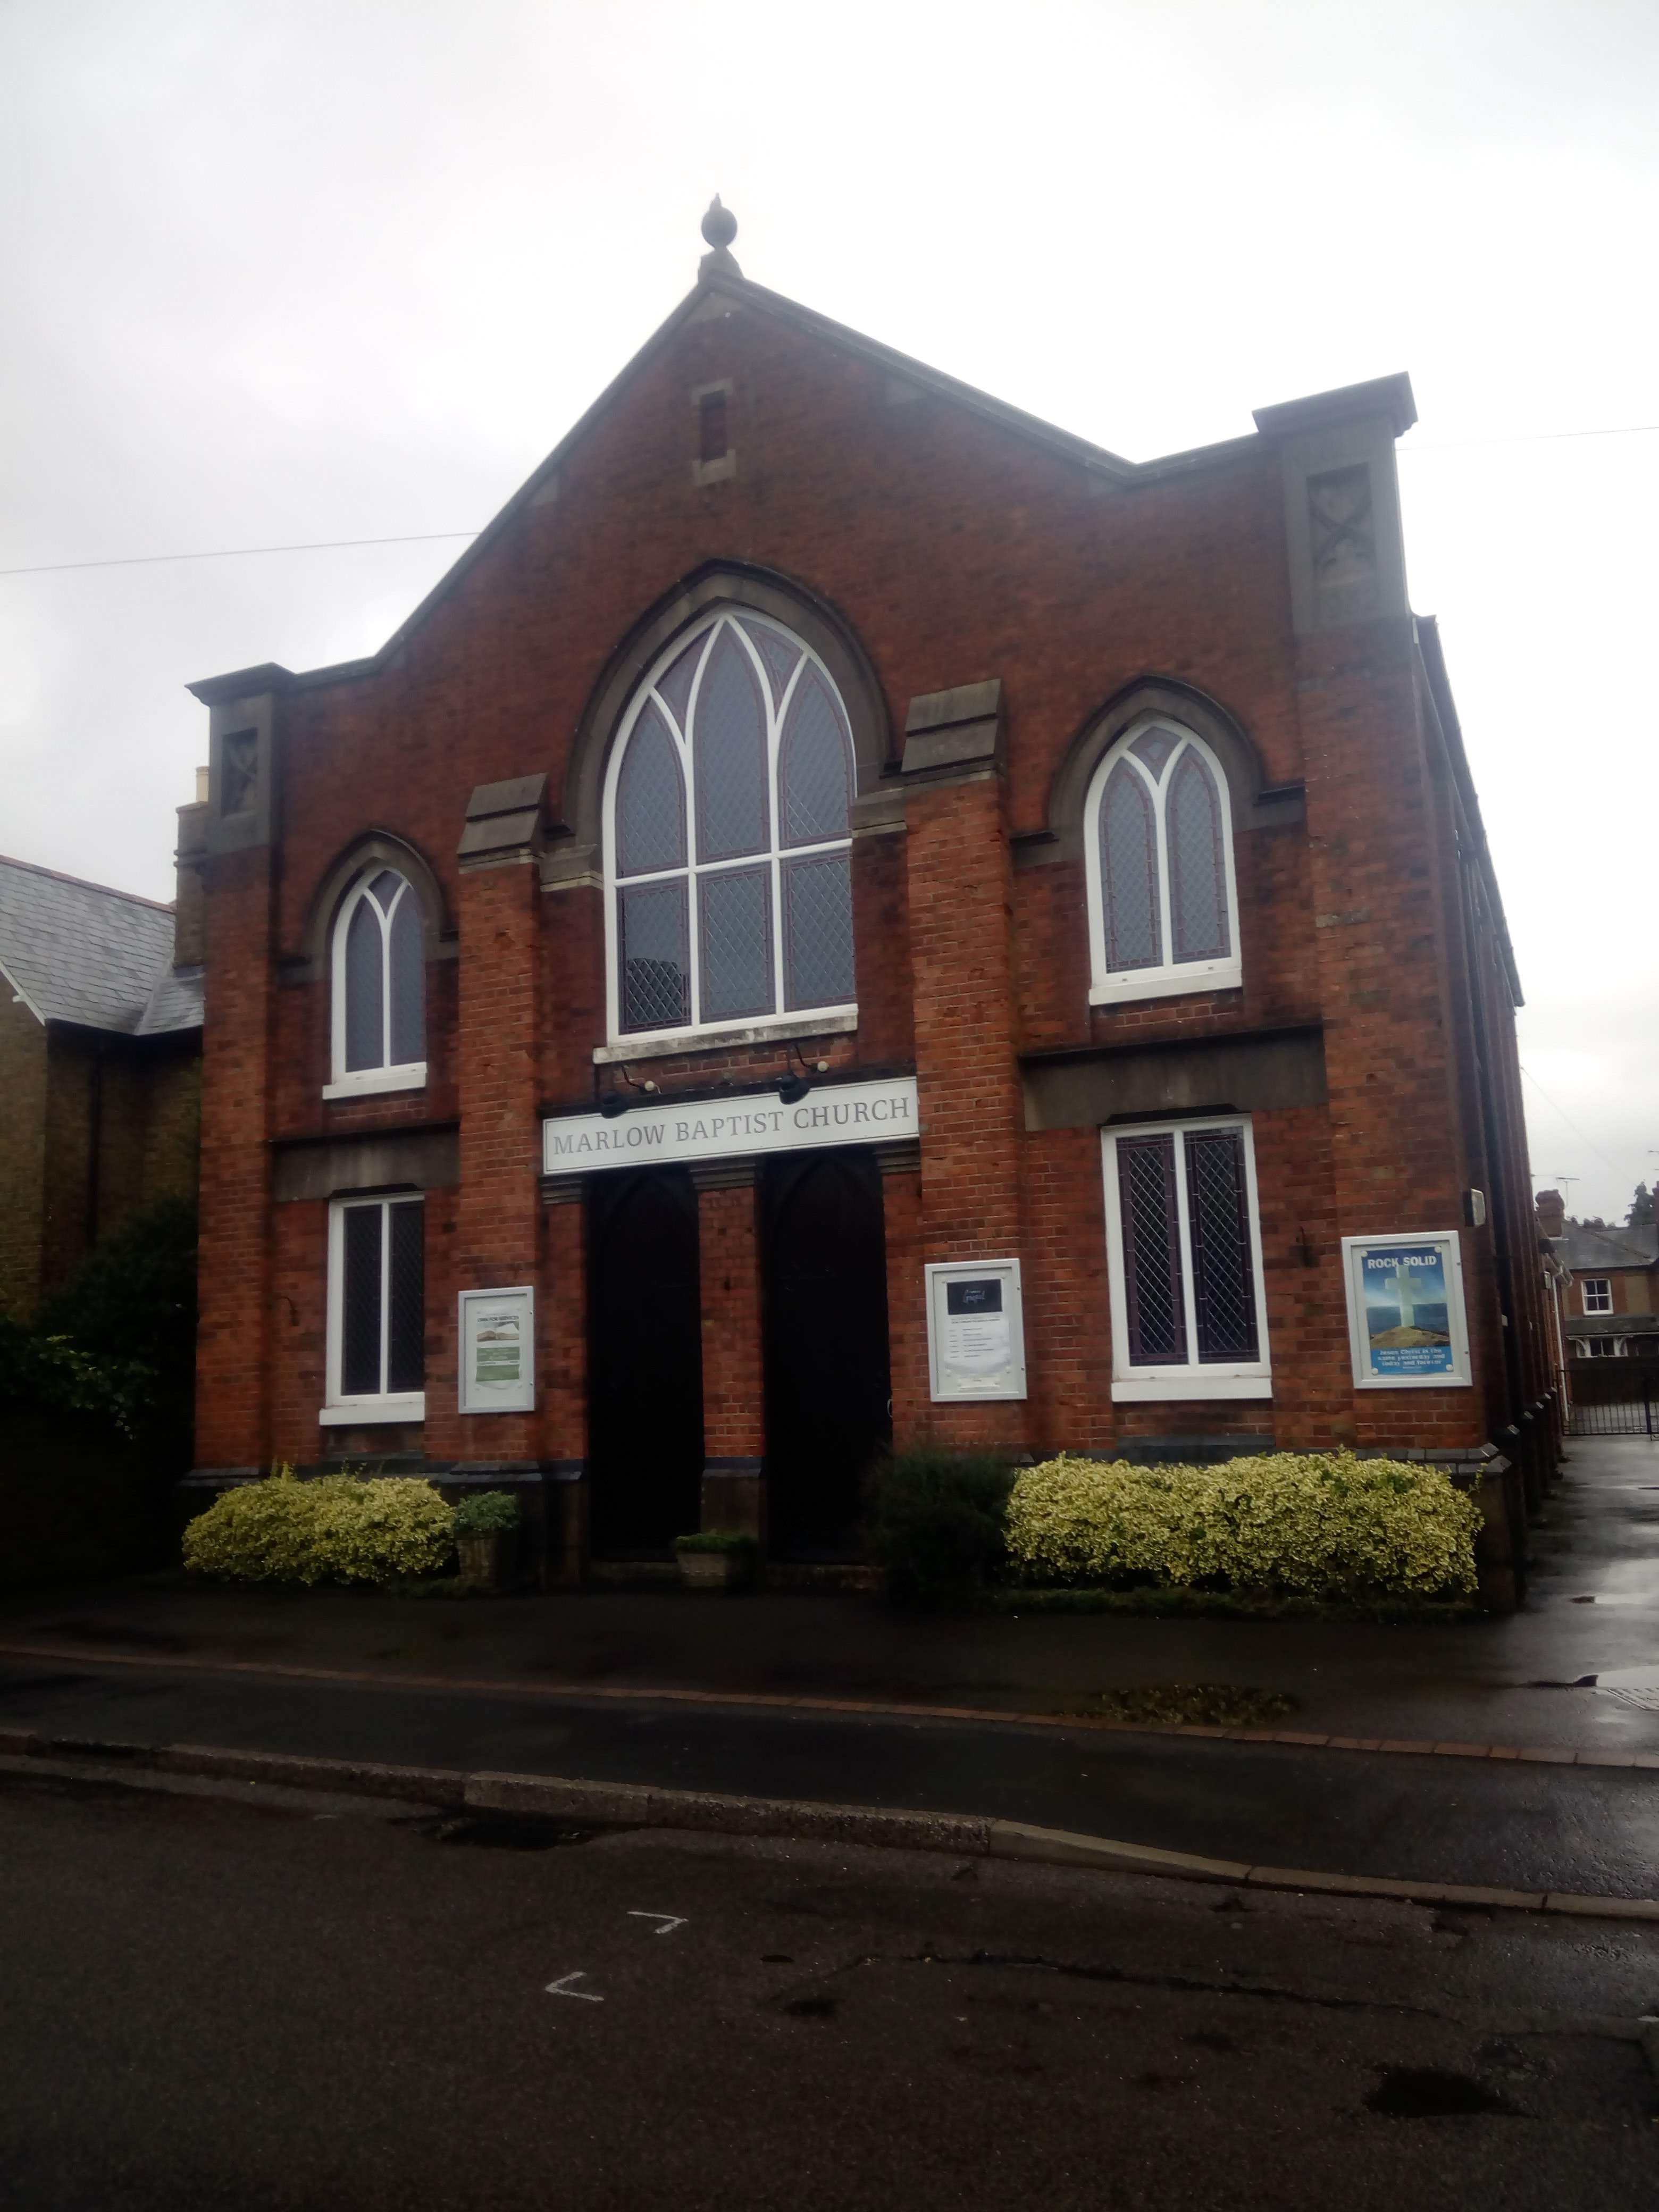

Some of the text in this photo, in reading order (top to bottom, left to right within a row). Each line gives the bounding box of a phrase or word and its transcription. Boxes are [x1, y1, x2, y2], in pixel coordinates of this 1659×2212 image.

[554, 1097, 909, 1155] MARLOW BAPTIST CHURCH
[1367, 1255, 1437, 1269] ROCK SOLID
